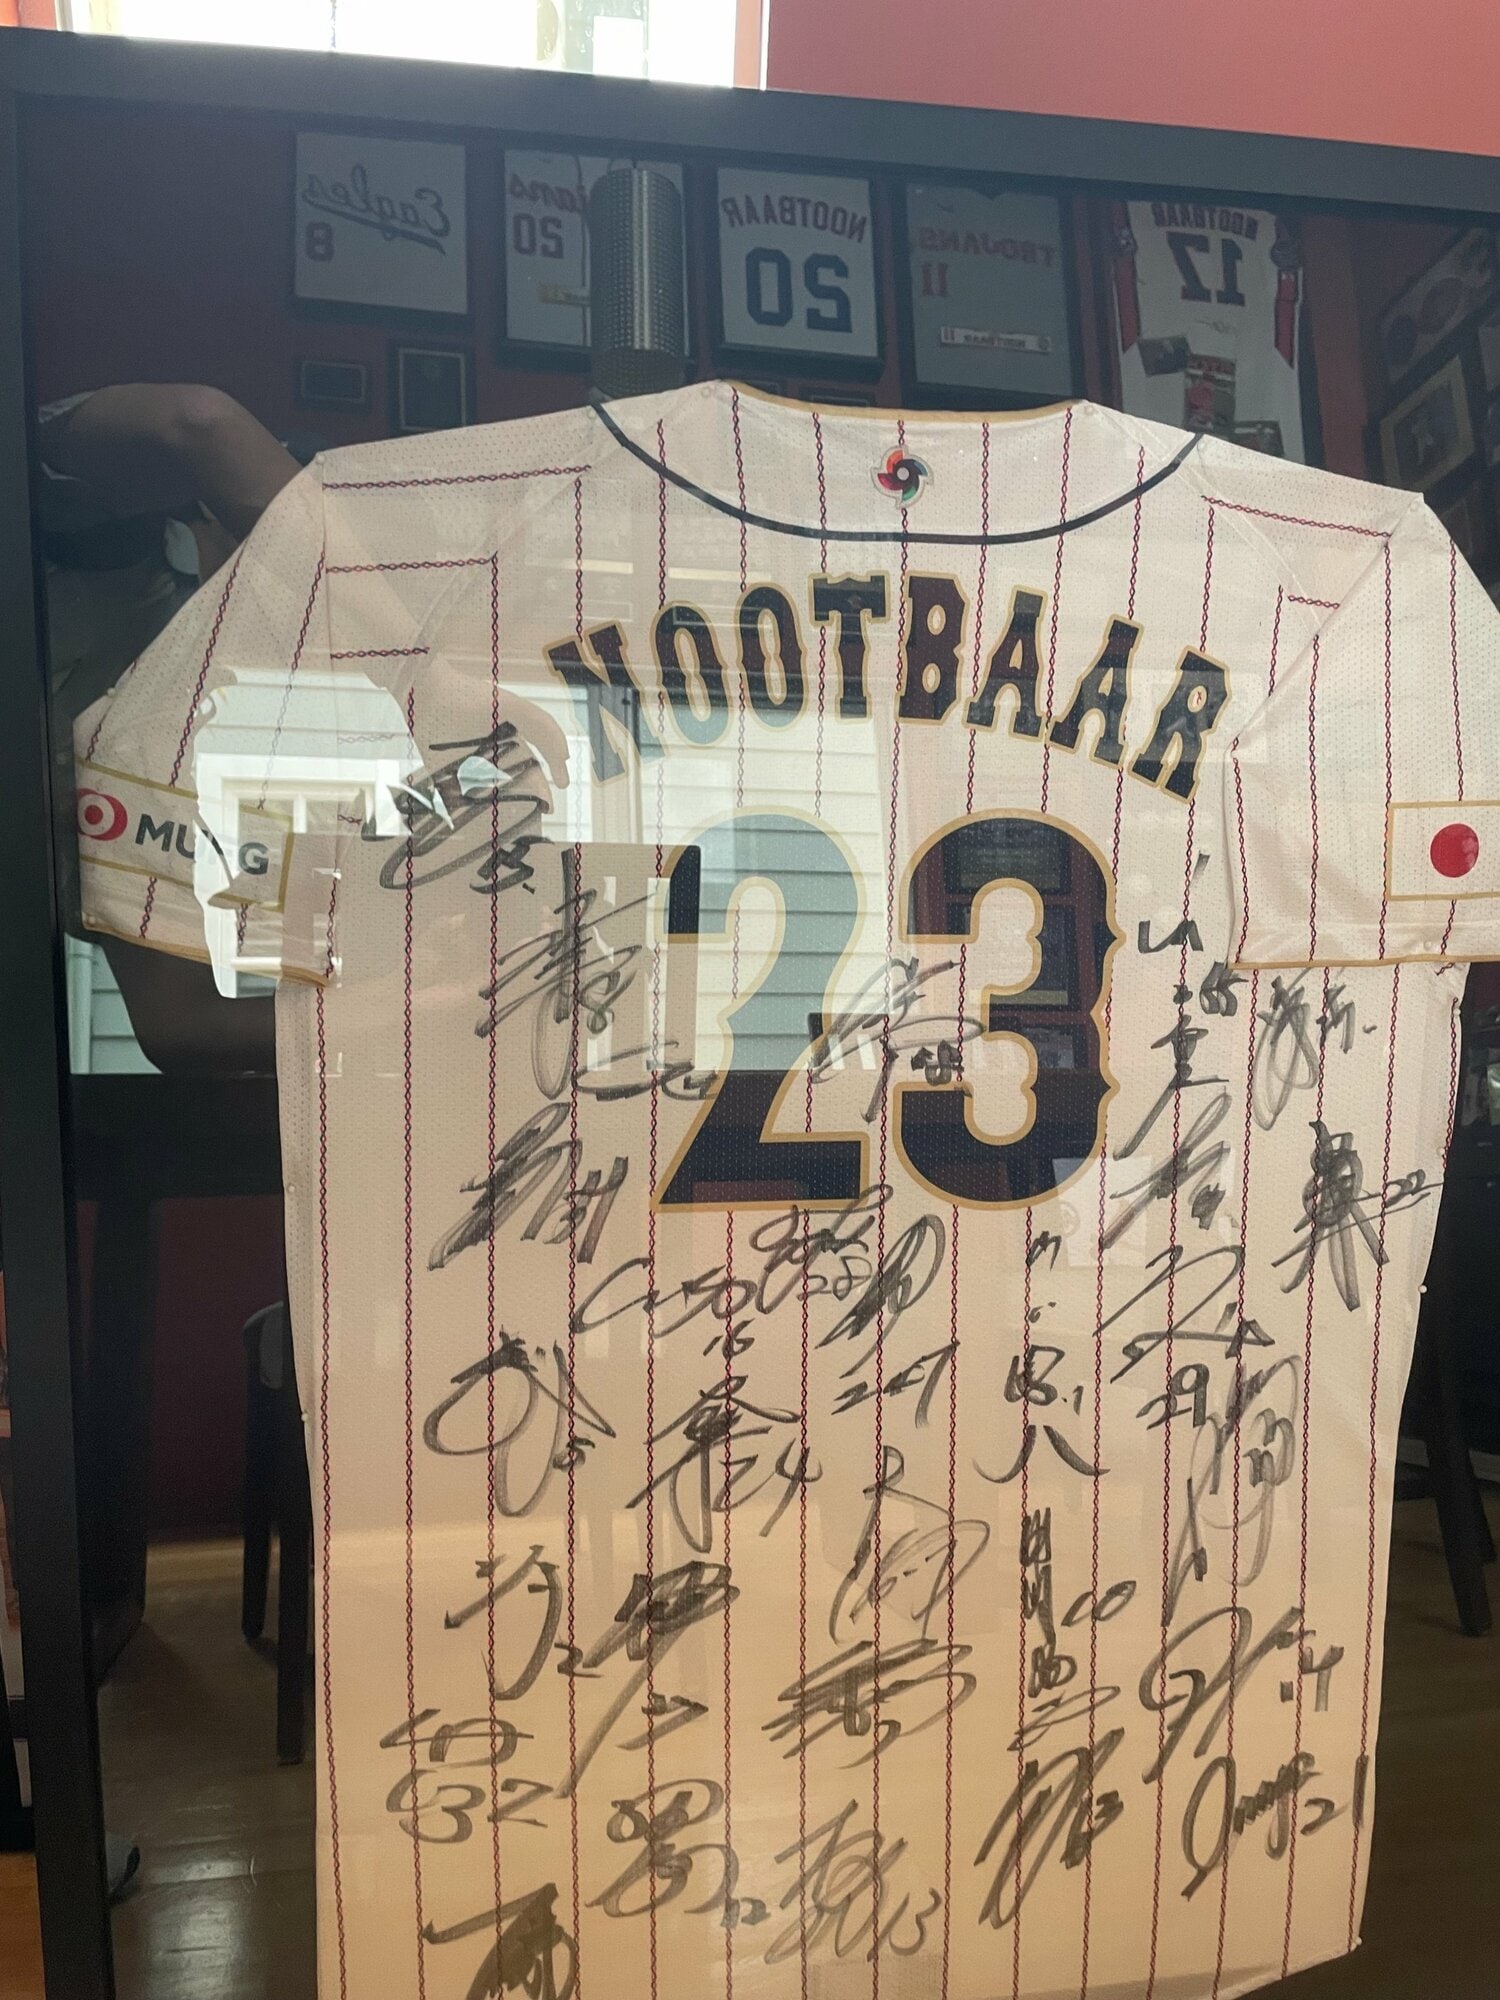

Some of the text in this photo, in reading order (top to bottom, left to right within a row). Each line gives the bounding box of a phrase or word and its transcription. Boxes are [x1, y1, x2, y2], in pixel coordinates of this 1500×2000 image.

[543, 572, 1230, 803] NOOTBAAR
[650, 805, 1126, 1214] 23
[1135, 1363, 1210, 1430] 29
